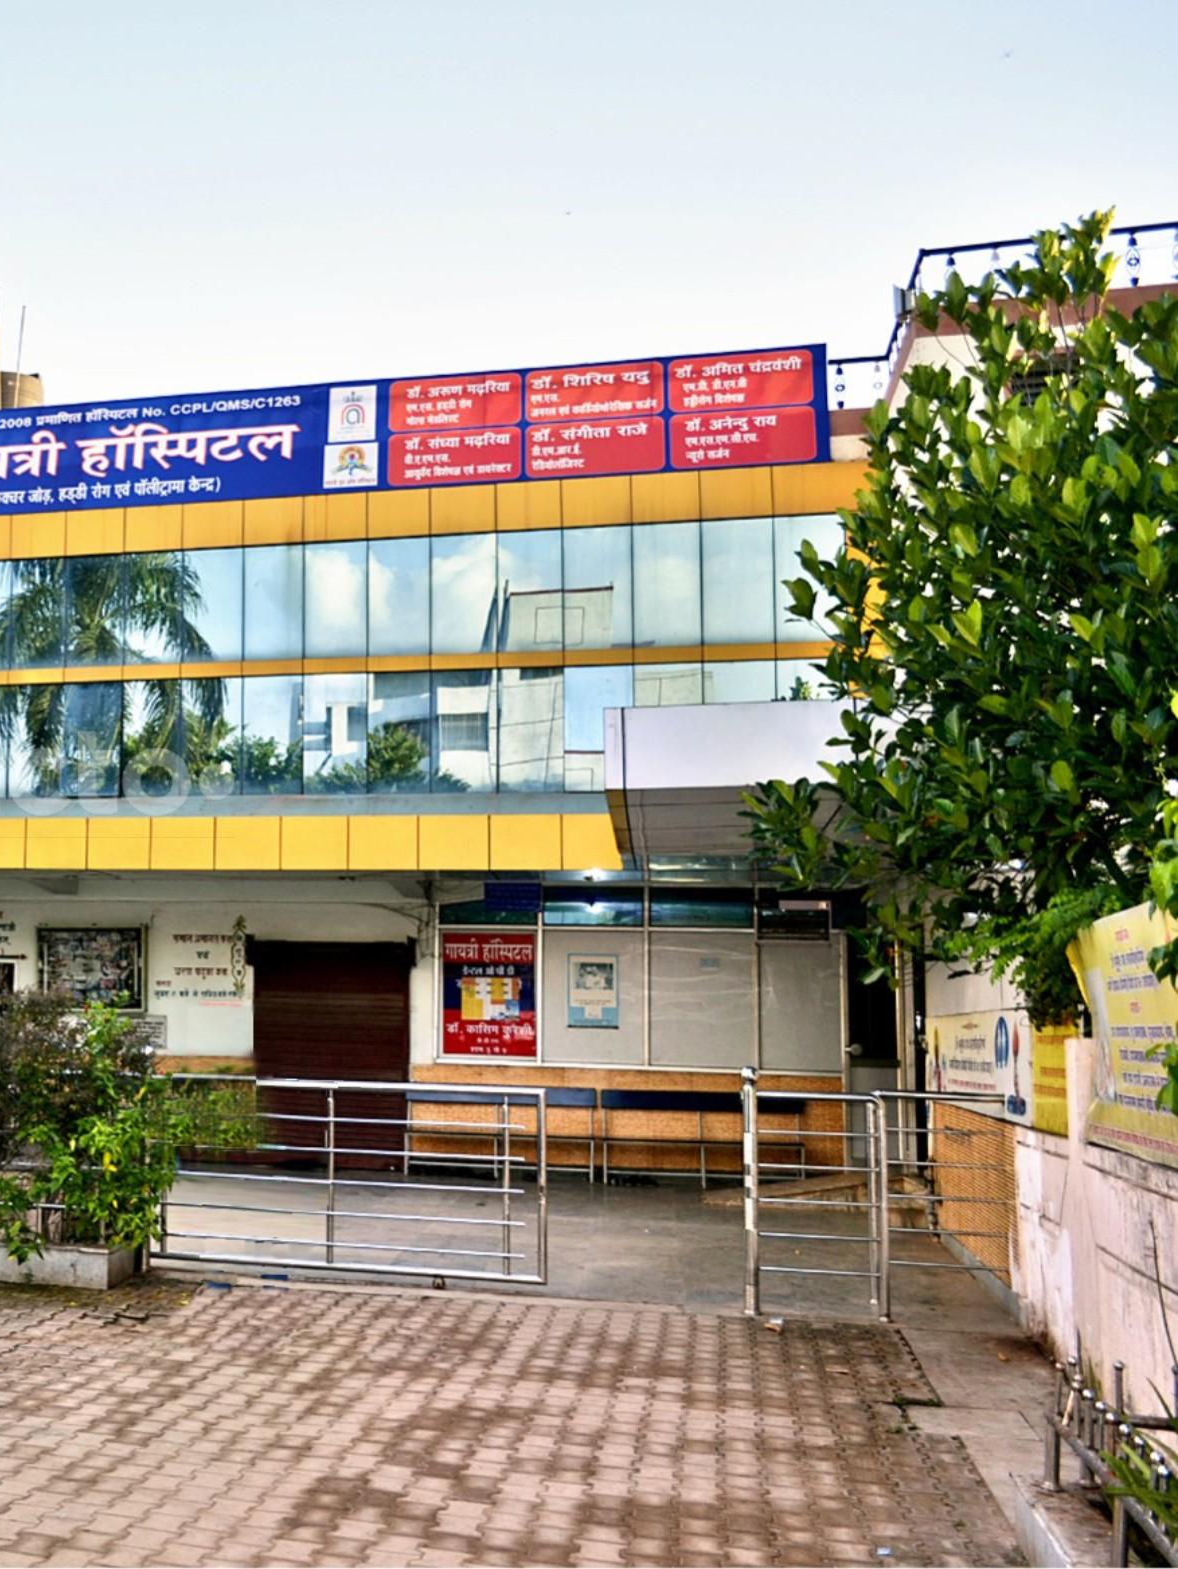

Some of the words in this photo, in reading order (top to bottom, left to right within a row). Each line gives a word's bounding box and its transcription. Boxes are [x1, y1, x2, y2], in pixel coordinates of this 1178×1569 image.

[675, 363, 698, 379] डॉ.
[702, 360, 744, 377] अमित
[531, 375, 557, 389] डॉ.
[36, 410, 82, 426] प्रमाणित
[85, 406, 139, 424] हॉस्पिटल
[142, 406, 166, 418] No.
[170, 395, 301, 415] CCPL/QMS/C1263
[685, 417, 706, 432] डॉ.
[753, 415, 777, 427] राय
[531, 428, 555, 442] डॉ.
[560, 425, 611, 440] संगीता
[75, 422, 302, 478] हॉस्पिटल
[91, 483, 111, 498] रोग
[114, 480, 131, 499] एवं
[445, 937, 479, 961] गायत्री
[482, 938, 533, 963] हॉस्पिटल
